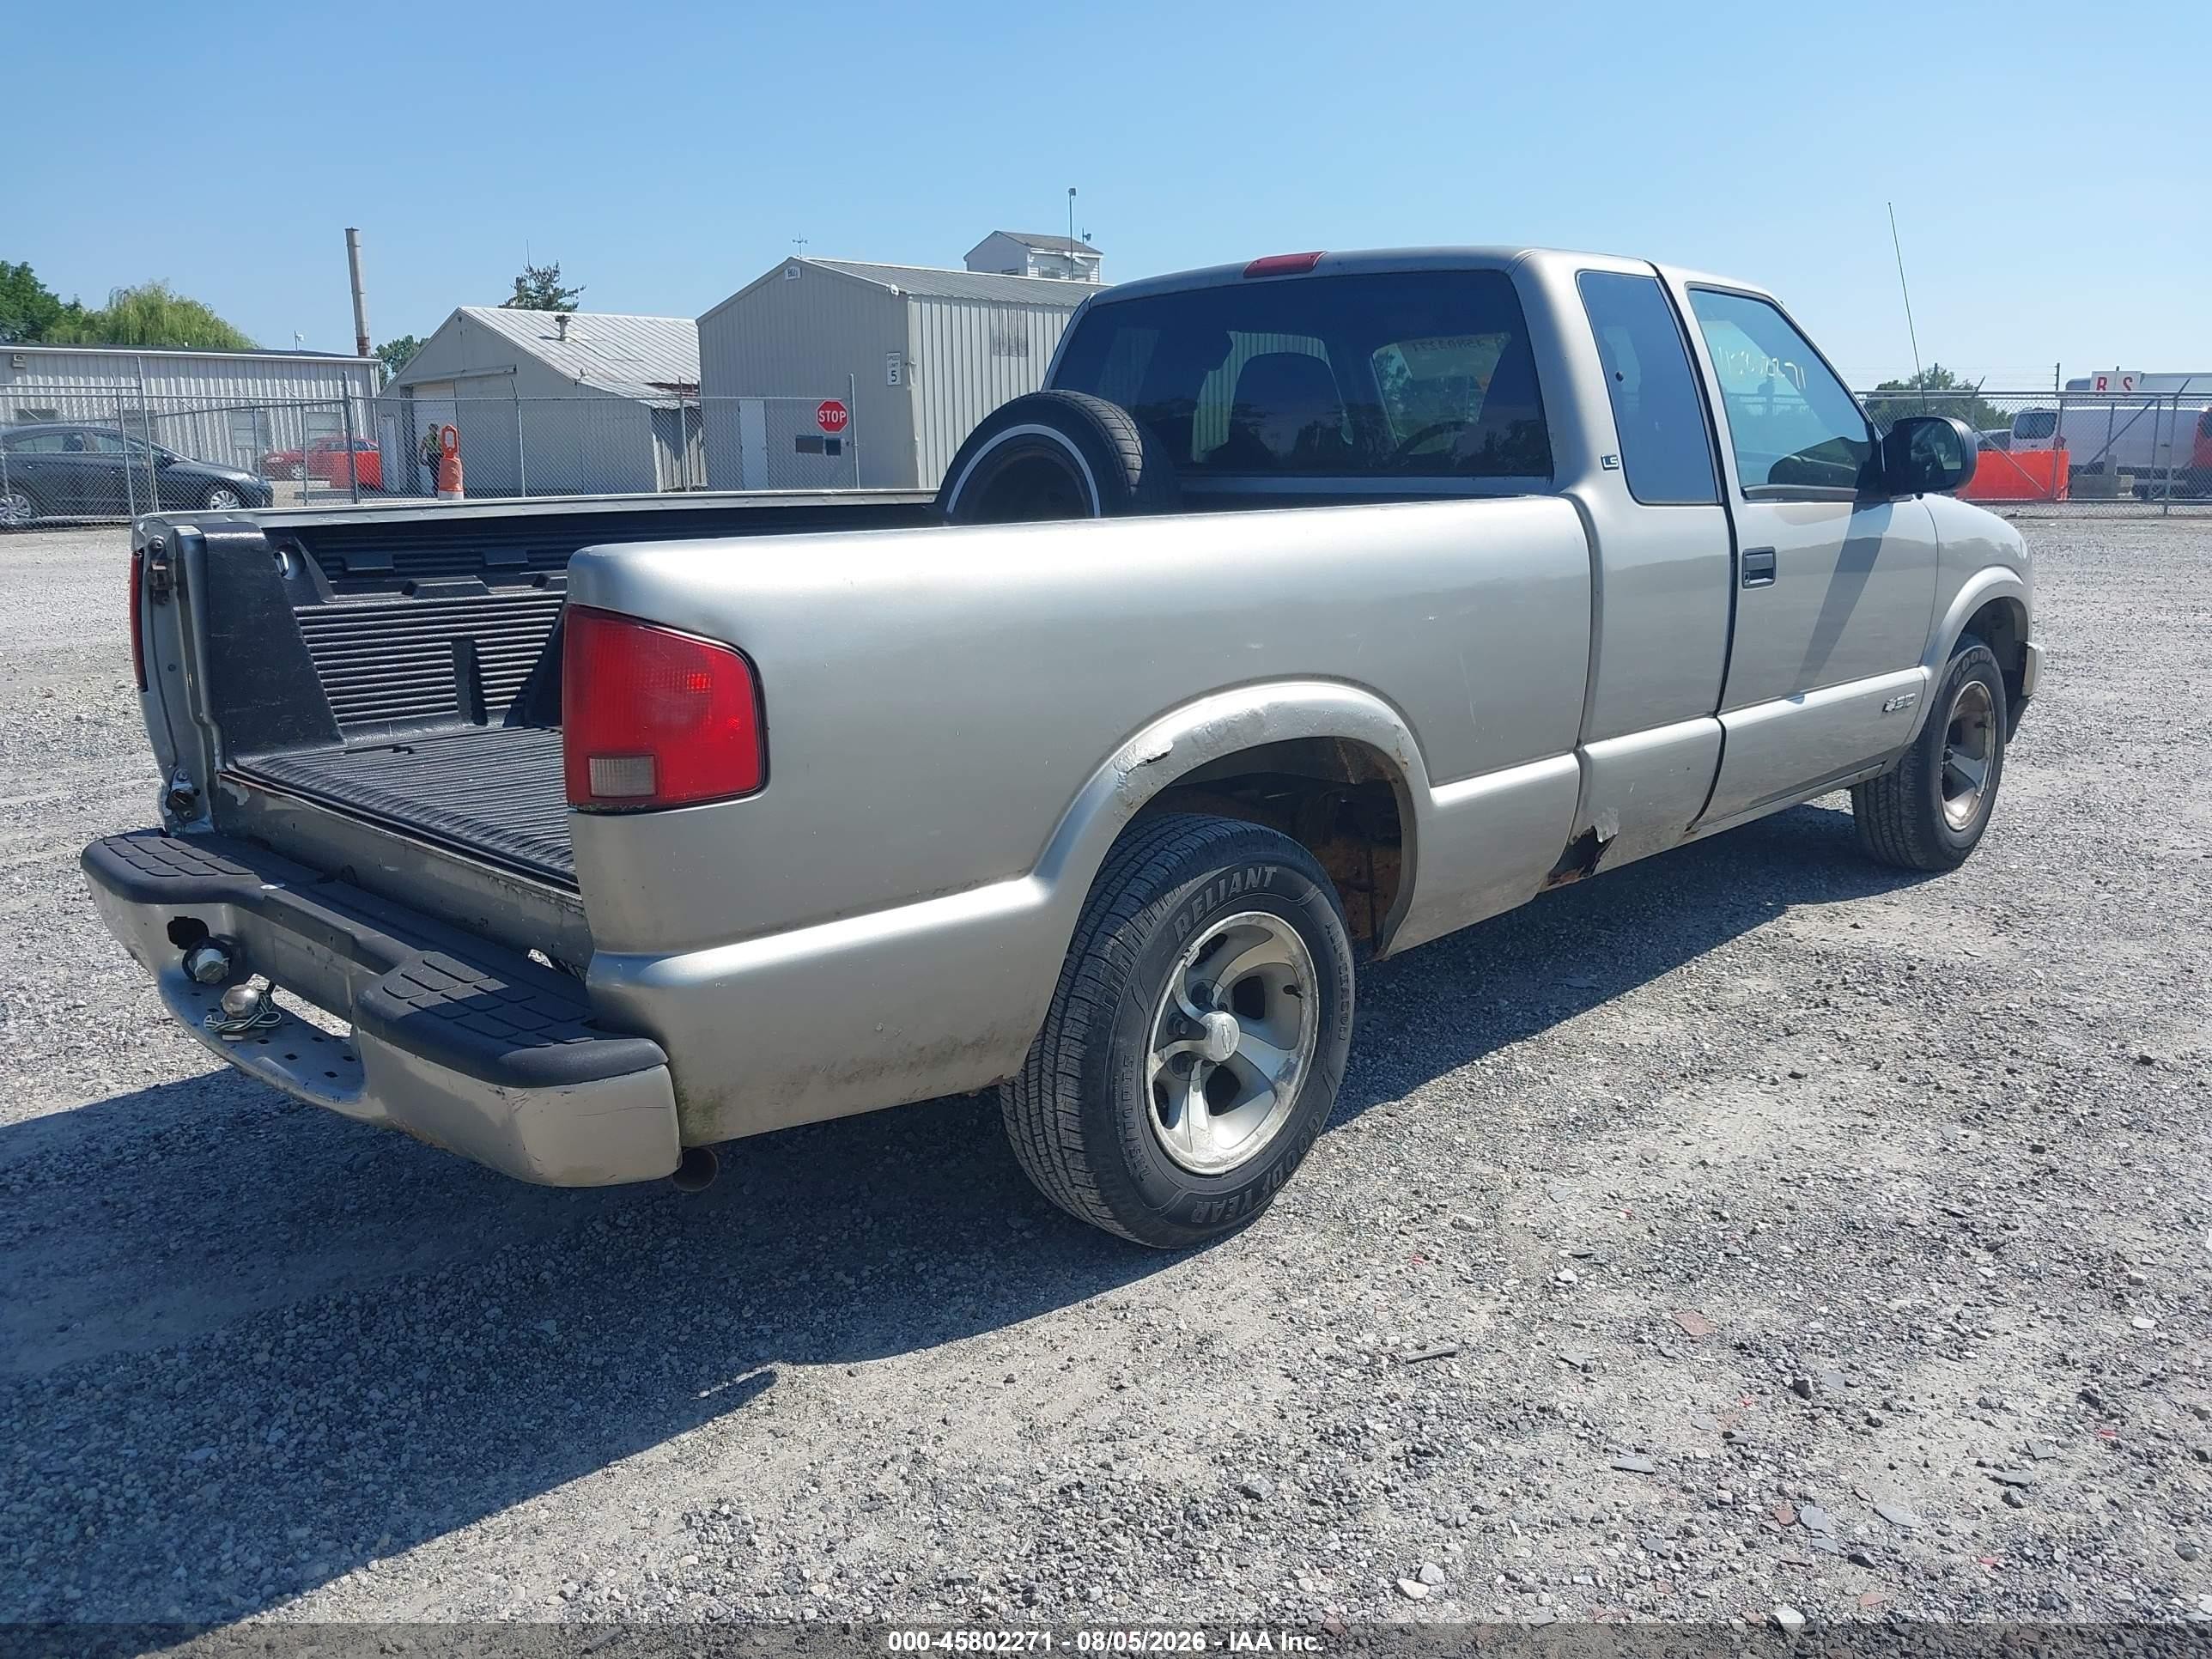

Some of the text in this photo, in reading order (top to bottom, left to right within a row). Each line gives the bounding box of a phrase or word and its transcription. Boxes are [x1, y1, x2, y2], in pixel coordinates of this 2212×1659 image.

[890, 370, 897, 383] 5
[2095, 376, 2133, 397] R S
[818, 410, 847, 423] STOP
[1601, 455, 1619, 468] LS
[1174, 866, 1278, 942] RELIANT
